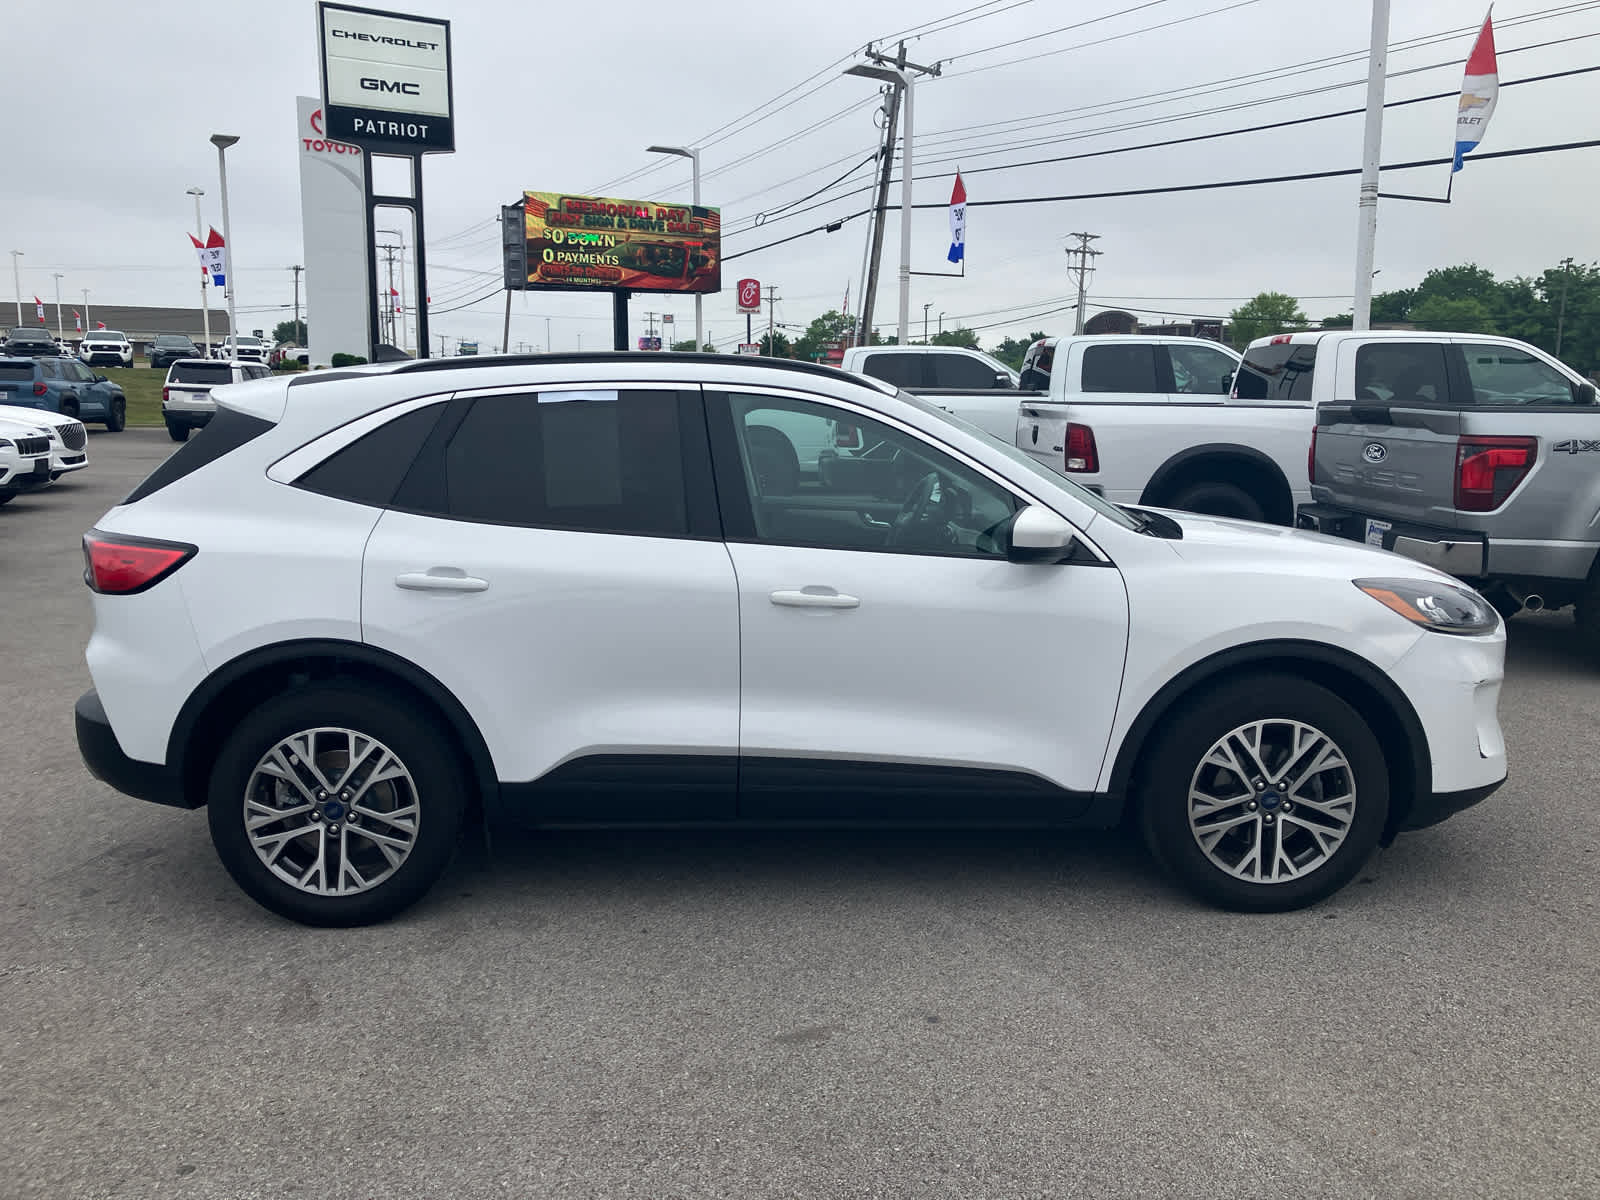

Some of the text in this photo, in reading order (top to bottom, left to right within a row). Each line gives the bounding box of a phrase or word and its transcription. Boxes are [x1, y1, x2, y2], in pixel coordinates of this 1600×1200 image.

[332, 29, 439, 51] CHEVROLET
[360, 77, 420, 95] GMC
[354, 118, 428, 138] PATRIOT
[566, 201, 686, 222] MEMORIAL DAY
[584, 214, 615, 229] SIGN
[629, 218, 665, 232] DRIVE
[567, 232, 617, 248] DOWN
[542, 248, 620, 266] 0 PAYMENTS
